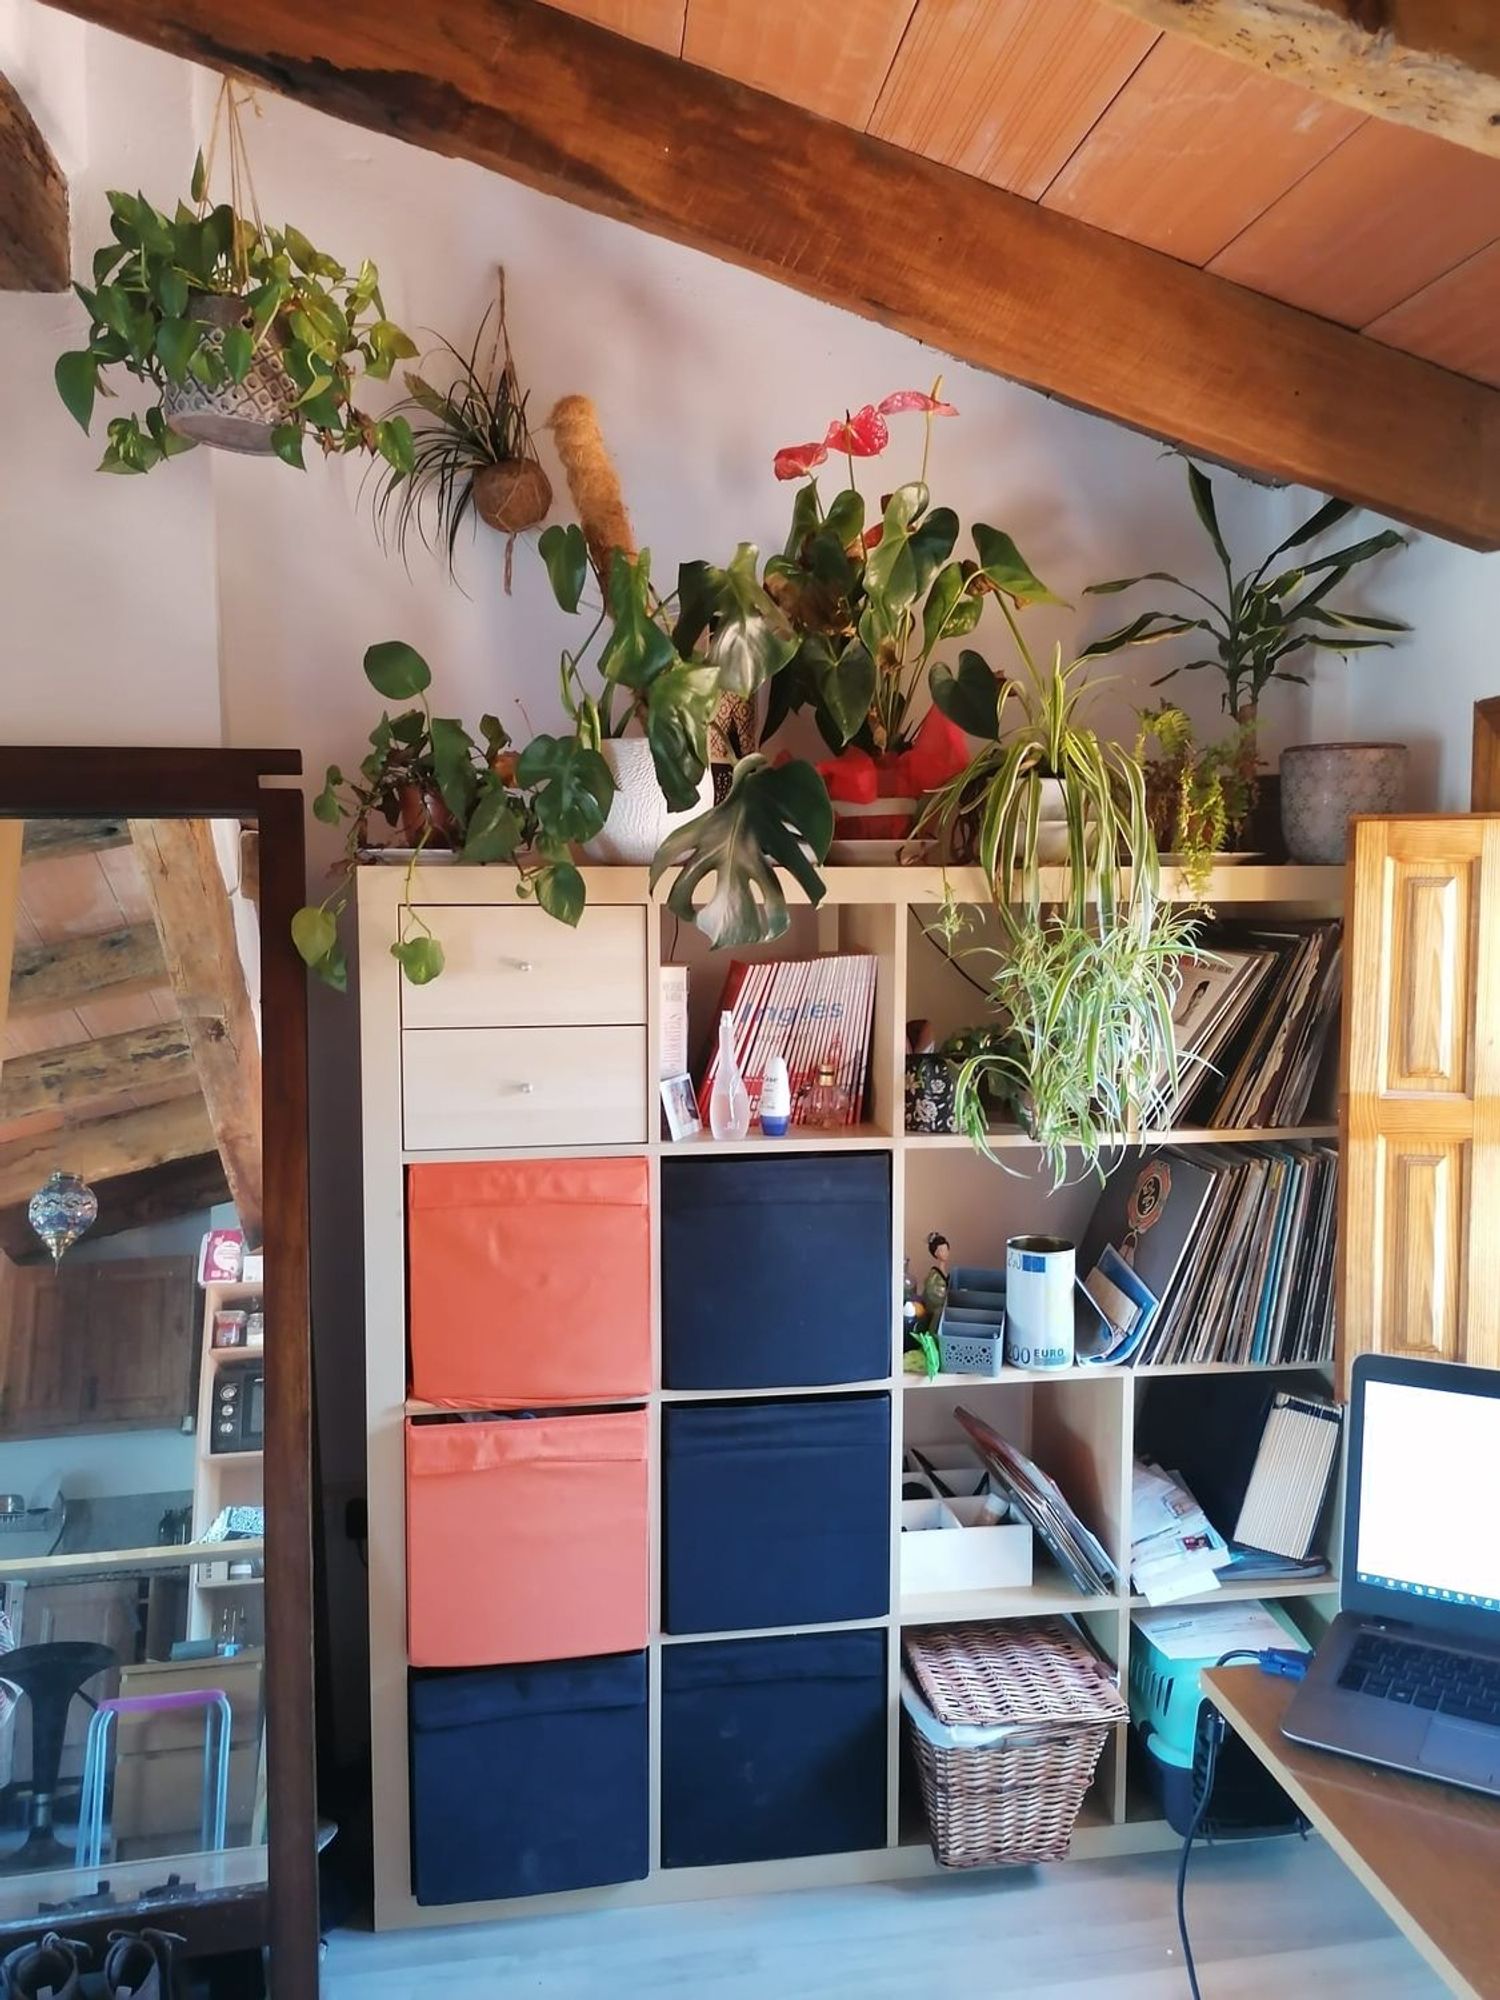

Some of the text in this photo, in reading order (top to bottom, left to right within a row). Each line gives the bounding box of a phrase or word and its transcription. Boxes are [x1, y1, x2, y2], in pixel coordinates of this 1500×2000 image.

[741, 998, 844, 1027] Inglés
[1007, 1343, 1064, 1364] 200 EURO
